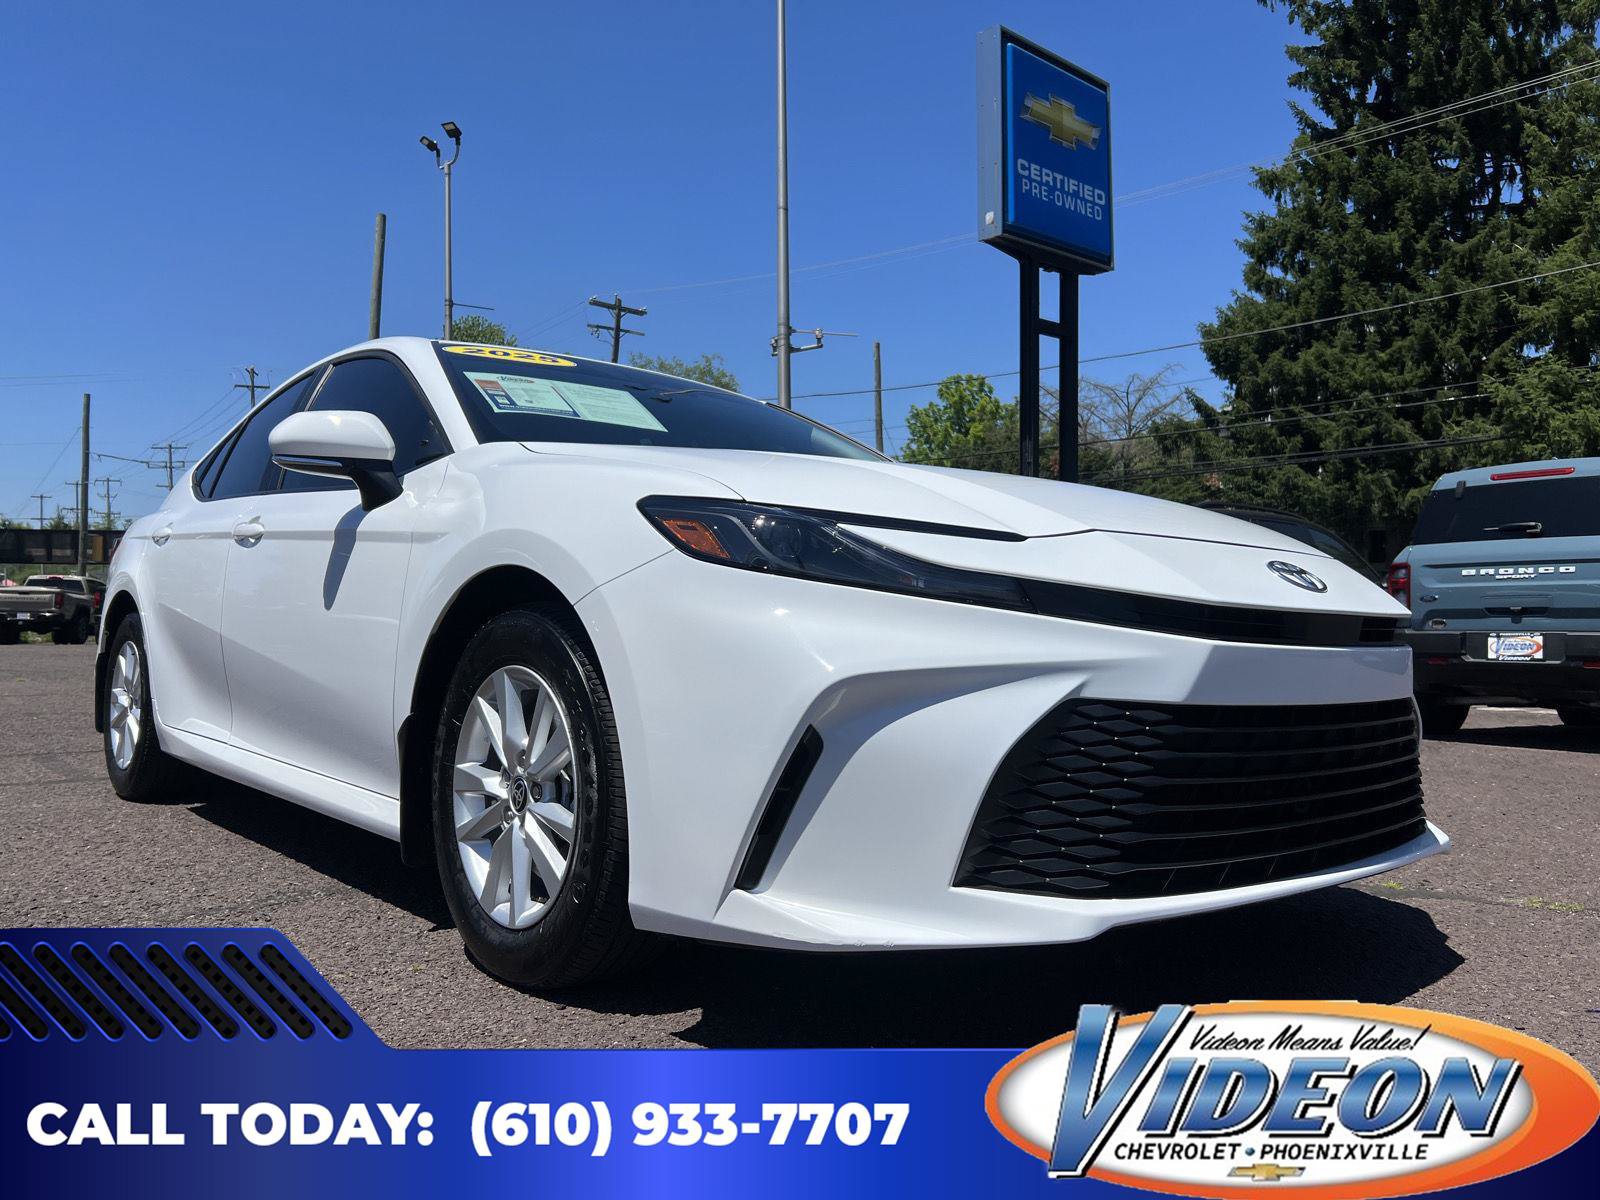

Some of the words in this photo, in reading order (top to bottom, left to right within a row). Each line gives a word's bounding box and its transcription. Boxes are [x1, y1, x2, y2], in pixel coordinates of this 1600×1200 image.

[1017, 158, 1106, 206] CERTIFIED
[1022, 178, 1102, 221] PRE-OWNED
[463, 348, 562, 363] 2025
[1461, 566, 1576, 576] BRONCO
